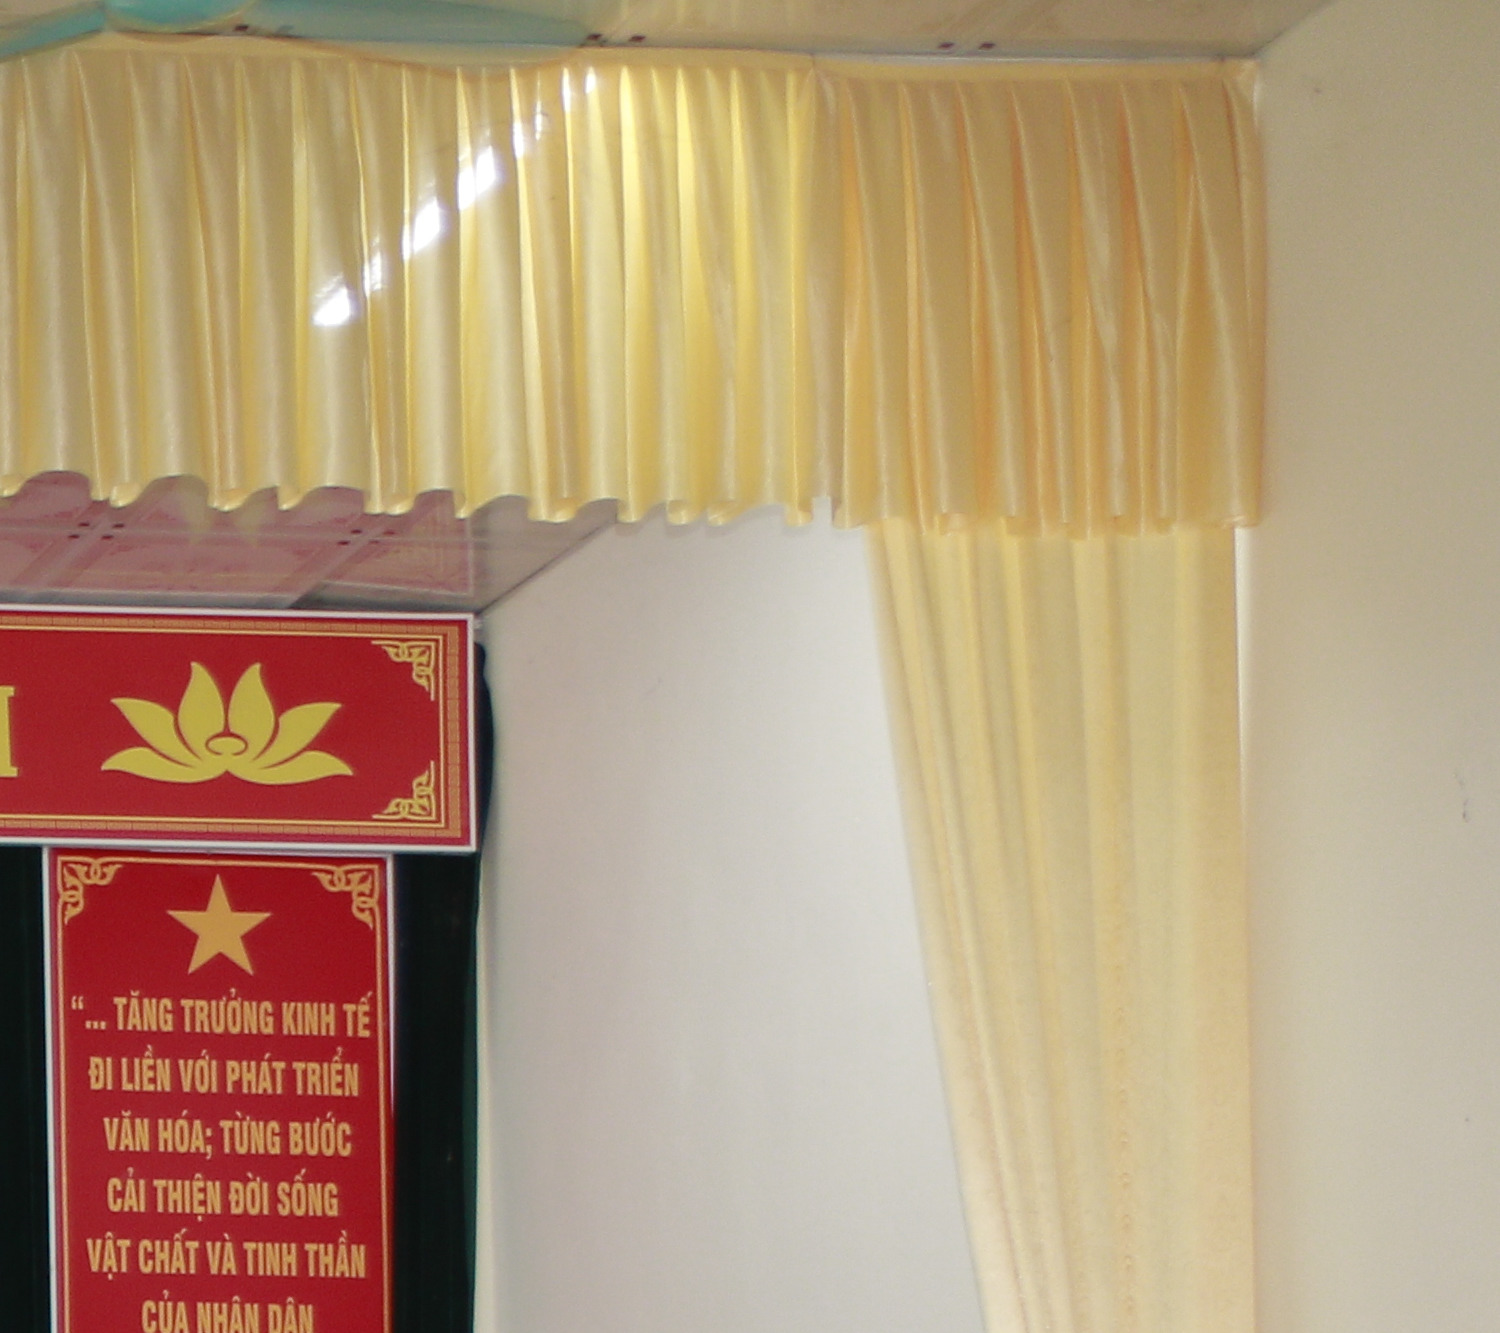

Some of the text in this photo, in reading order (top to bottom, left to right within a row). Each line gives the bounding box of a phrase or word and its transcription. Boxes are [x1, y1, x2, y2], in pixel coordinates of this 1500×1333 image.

[71, 987, 373, 1038] “... TĂNG TRƯỞNG KINH TẾ
[87, 1044, 359, 1097] ĐI LIỀN VỚI PHÁT TRIỂN
[102, 1109, 352, 1160] VĂN HÓA; TỪNG BƯỚC
[107, 1166, 339, 1222] CẢI THIỆN ĐỜI SỐNG
